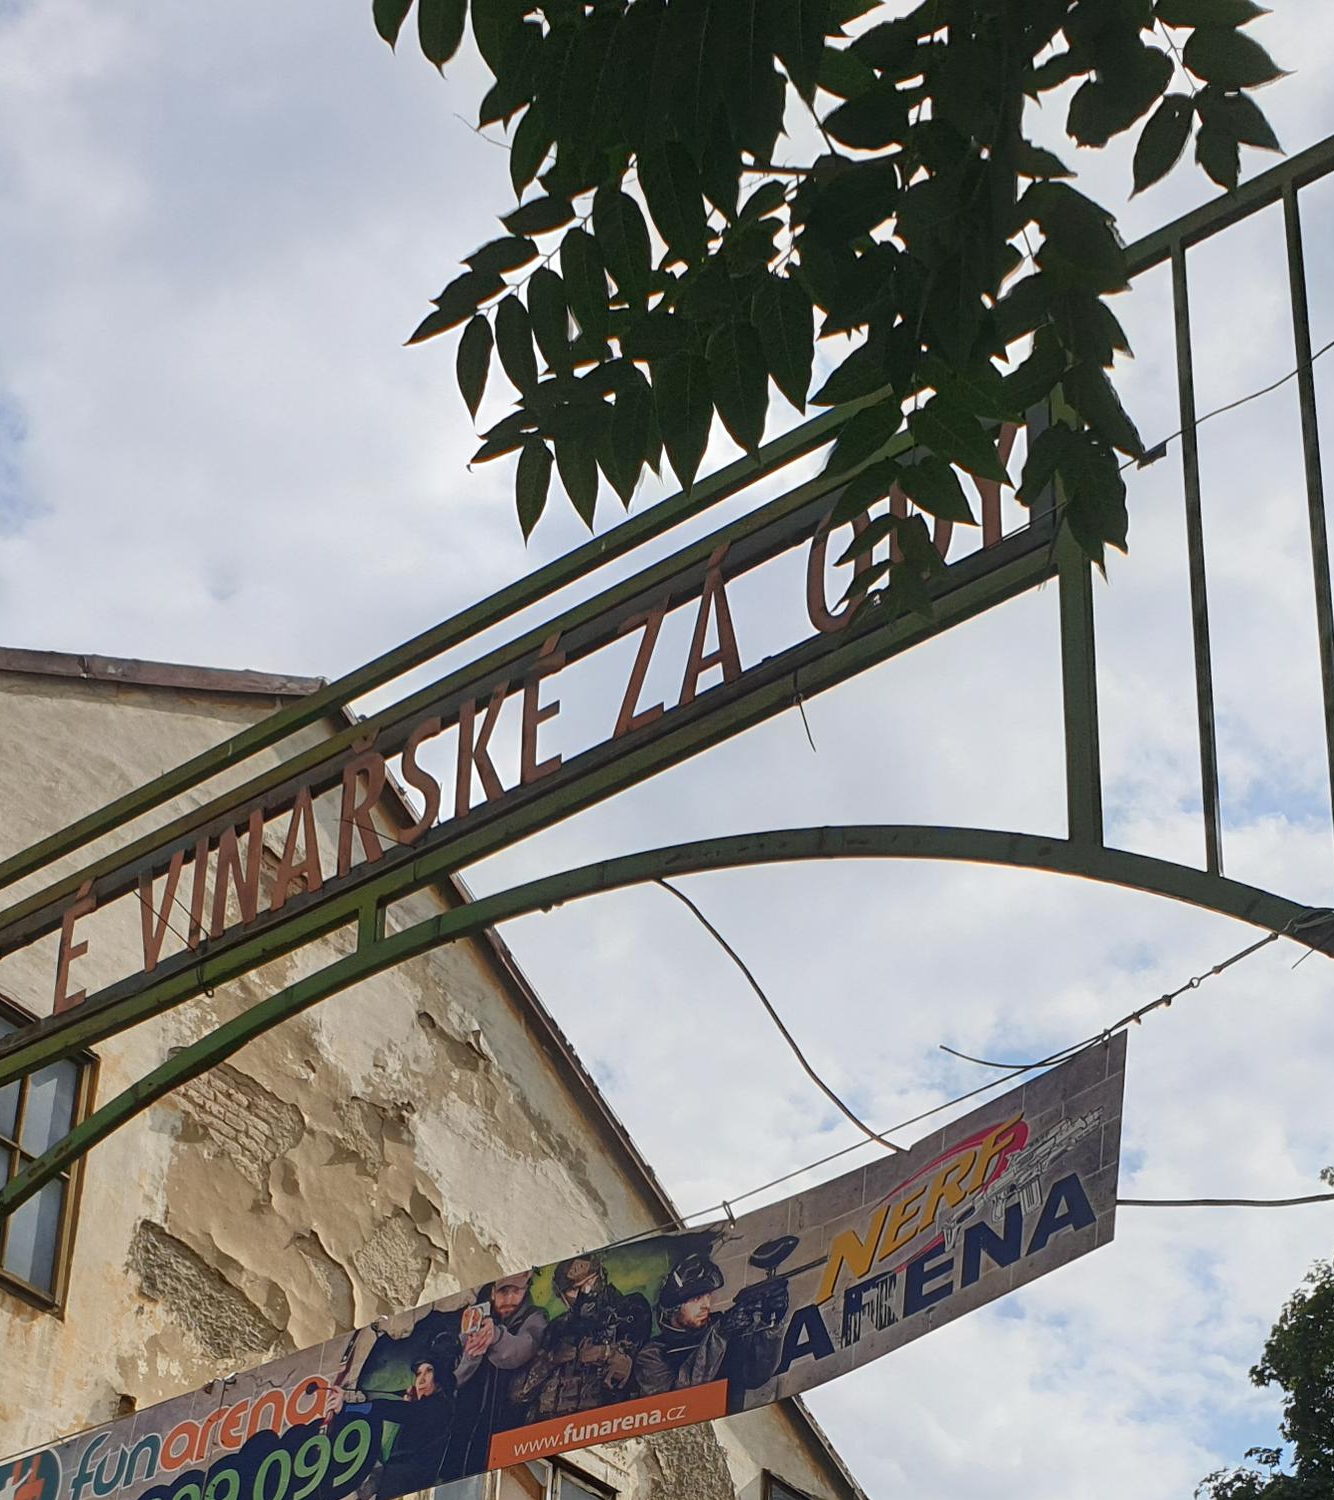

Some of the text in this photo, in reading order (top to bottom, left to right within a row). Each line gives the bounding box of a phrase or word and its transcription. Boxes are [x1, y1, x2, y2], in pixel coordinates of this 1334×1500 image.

[138, 631, 566, 972] VINAŘSKÉ
[771, 1172, 1098, 1377] ARENA
[816, 1111, 1026, 1306] NERF
[513, 1404, 687, 1457] www.funarena.cz
